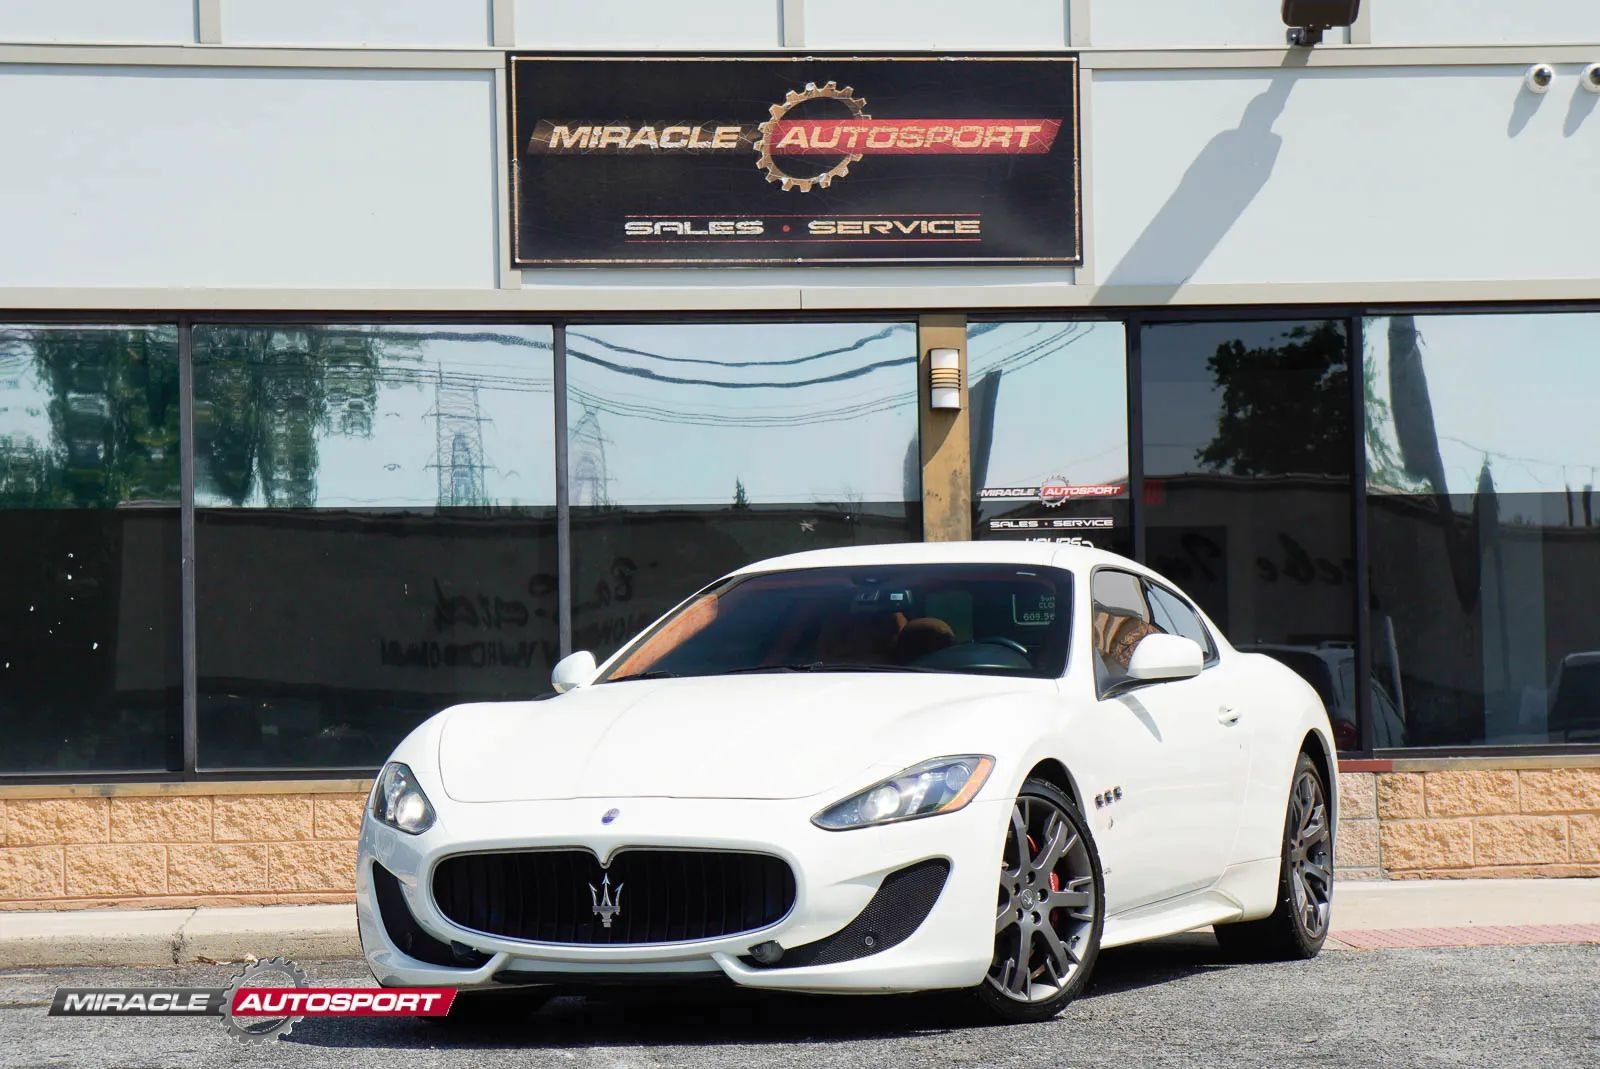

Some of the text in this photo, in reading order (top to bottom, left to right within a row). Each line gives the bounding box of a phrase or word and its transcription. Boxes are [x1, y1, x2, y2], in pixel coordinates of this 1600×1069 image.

[548, 124, 1043, 150] MIRACLE AUTOSPORT
[624, 219, 982, 236] SALES SERVICE
[980, 486, 1121, 497] MIRACLE AUTOSPORT
[989, 519, 1114, 528] SALES SERVICE
